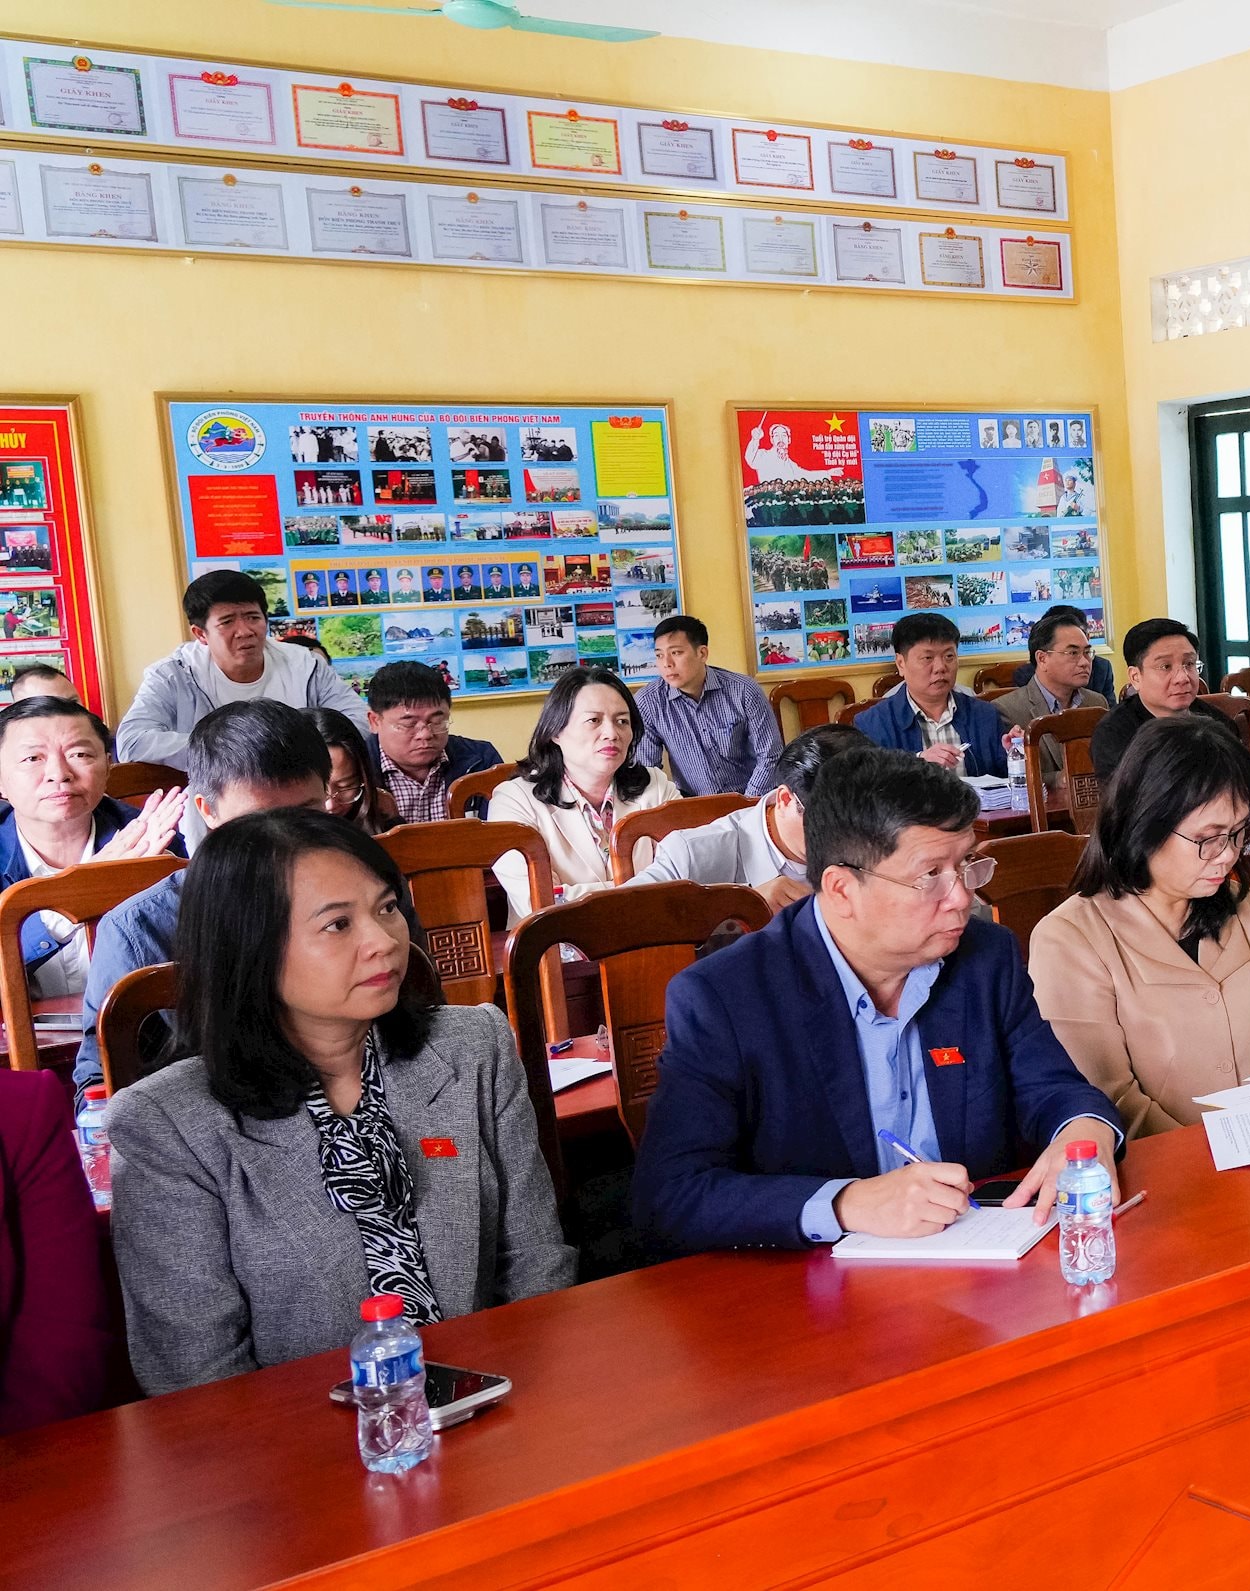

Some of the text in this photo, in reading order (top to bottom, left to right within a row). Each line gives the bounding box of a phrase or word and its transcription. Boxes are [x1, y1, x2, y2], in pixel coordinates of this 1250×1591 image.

[85, 90, 111, 98] KHEN
[99, 192, 123, 200] KHEN
[300, 409, 560, 423] TRUYỀN THỐNG ANH HÙNG CỦA BỘ ĐỘI BIÊN PHÒNG VIỆT NAM
